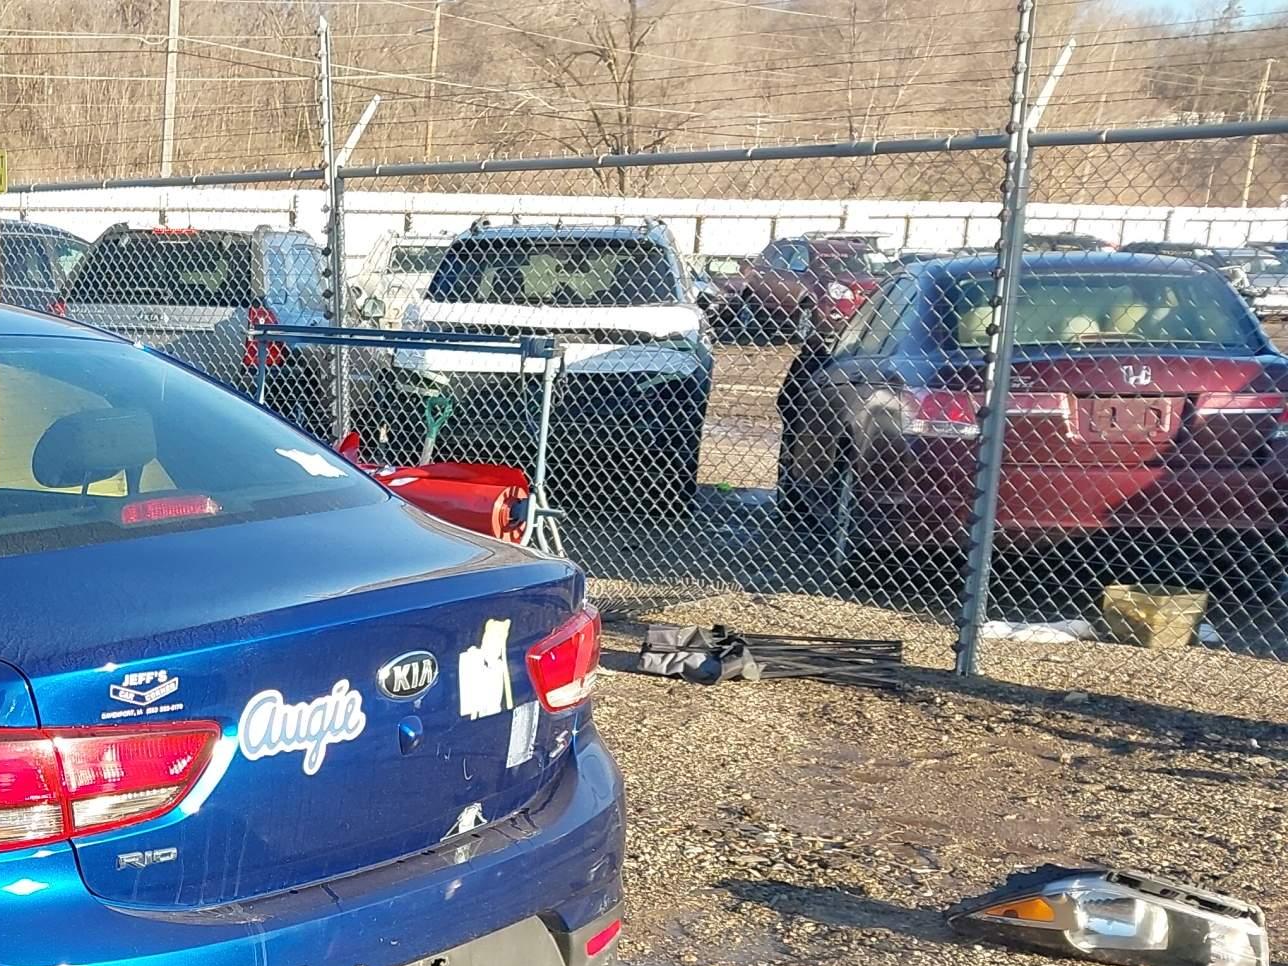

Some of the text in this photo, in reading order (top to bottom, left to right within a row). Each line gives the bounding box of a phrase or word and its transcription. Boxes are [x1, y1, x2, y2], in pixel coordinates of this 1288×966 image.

[122, 669, 168, 687] JEFF'S
[392, 659, 433, 692] KIA
[118, 690, 135, 701] CAR
[116, 847, 178, 871] RIO
